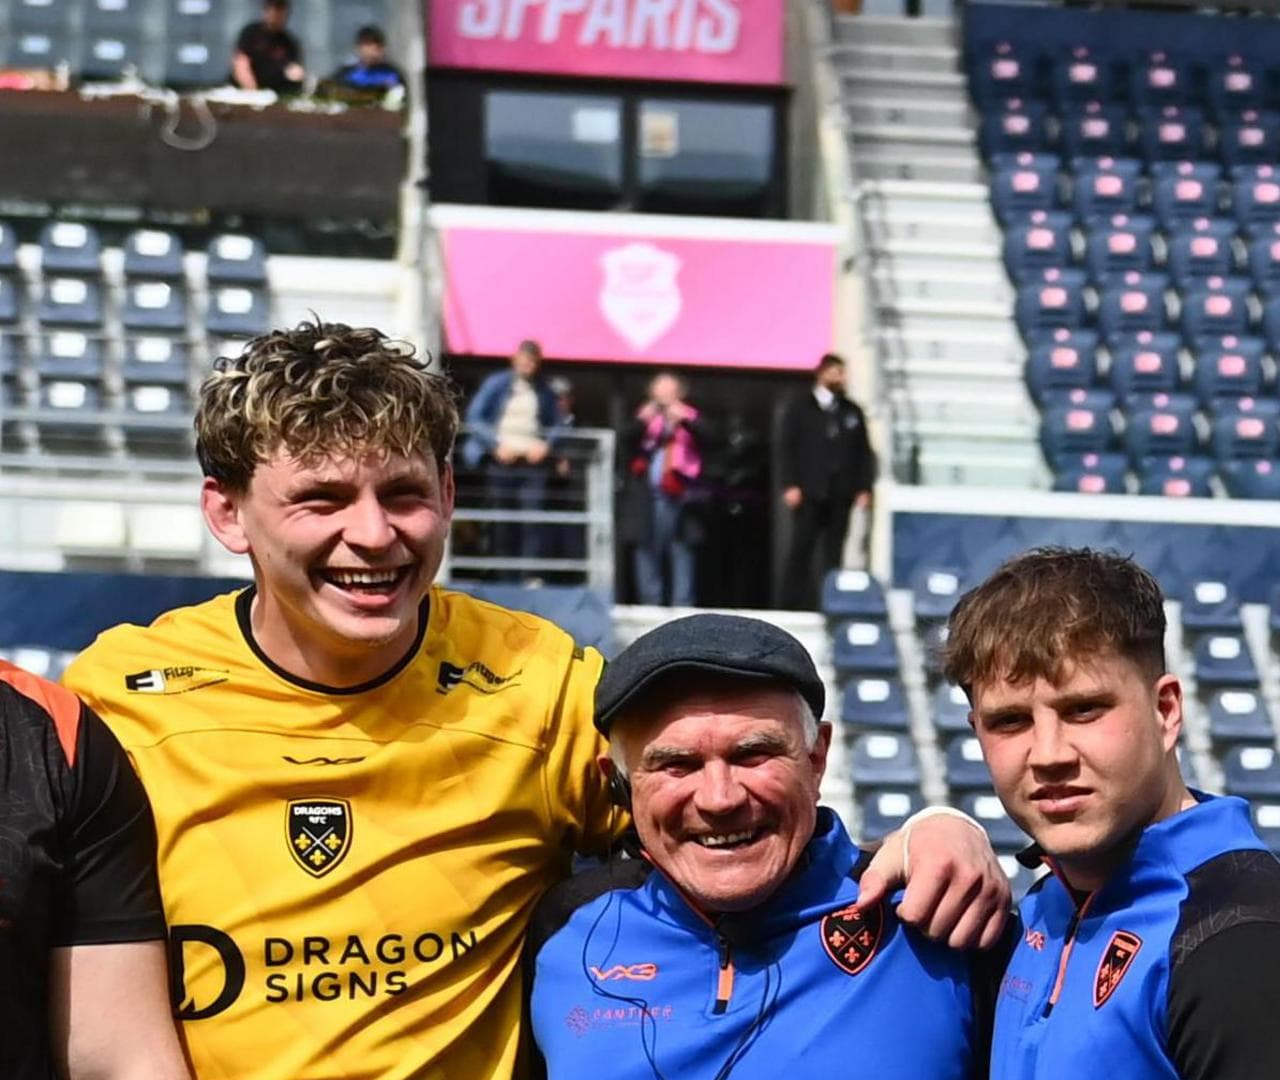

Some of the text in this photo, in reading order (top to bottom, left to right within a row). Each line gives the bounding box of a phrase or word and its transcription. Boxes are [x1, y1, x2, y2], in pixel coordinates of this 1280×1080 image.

[293, 806, 343, 816] DRAGONS
[264, 930, 479, 967] DRAGON
[265, 970, 410, 1003] SIGNS
